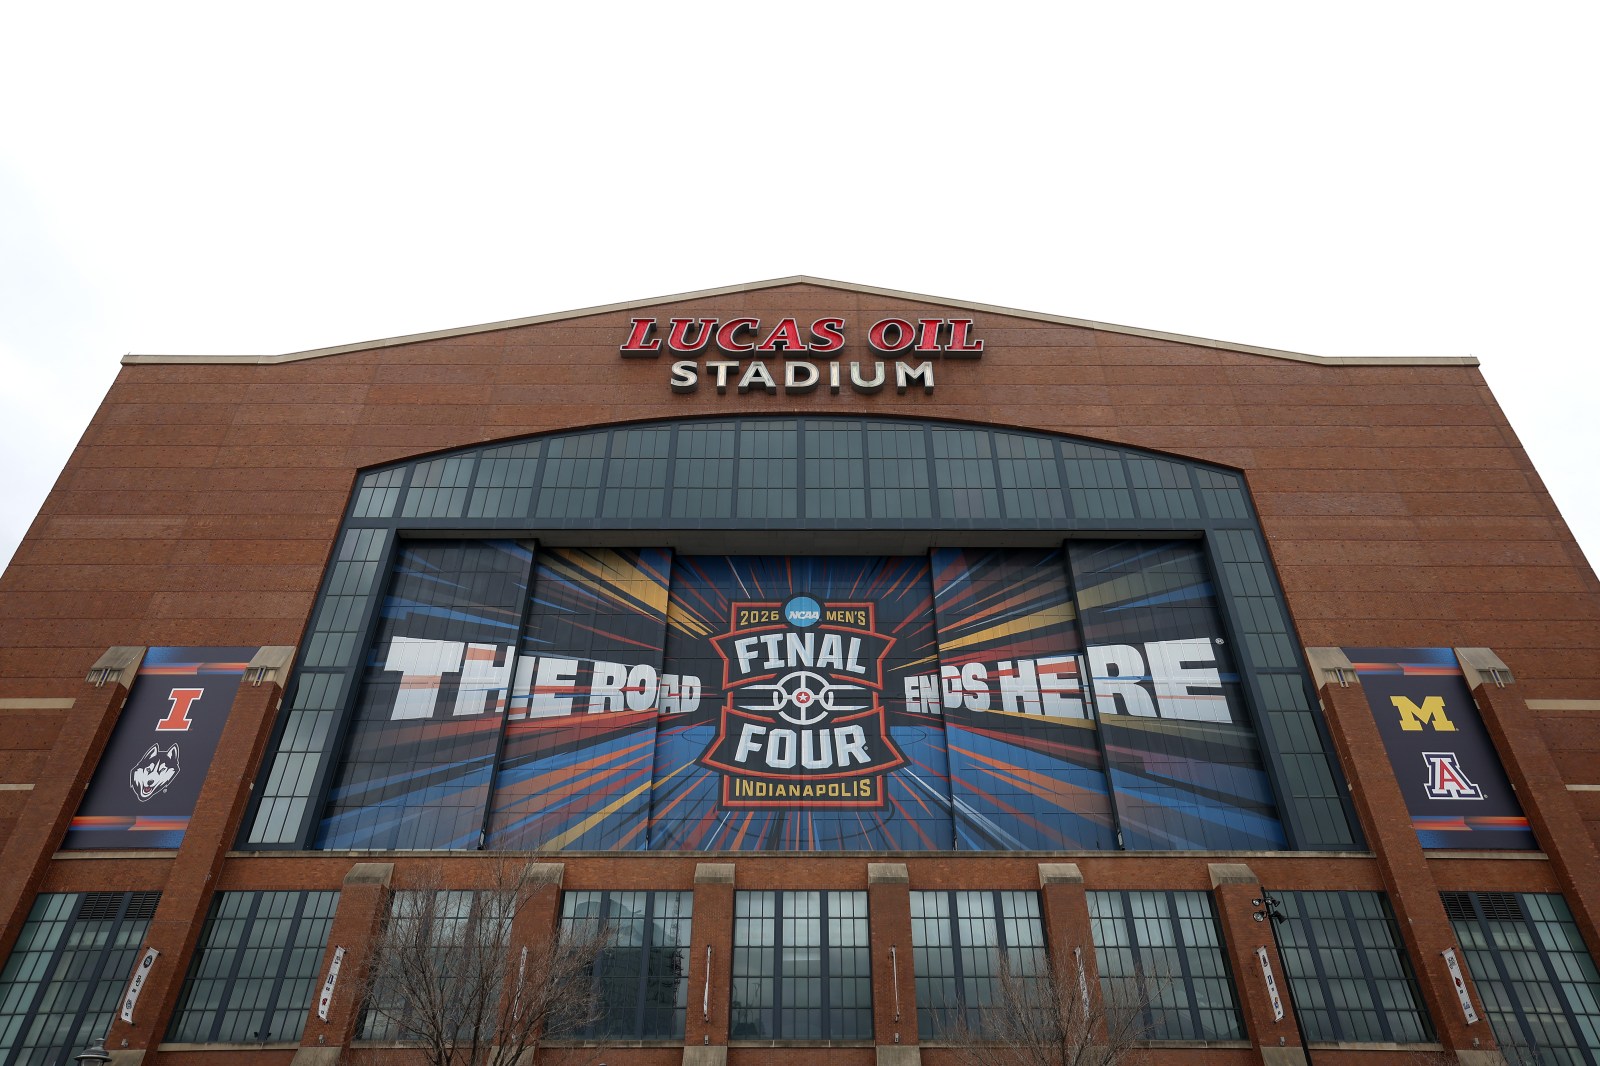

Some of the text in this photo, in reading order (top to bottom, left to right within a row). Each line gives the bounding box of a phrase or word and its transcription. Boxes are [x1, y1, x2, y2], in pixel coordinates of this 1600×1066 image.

[620, 317, 985, 358] LUCAS OIL
[670, 360, 936, 394] STADIUM
[740, 610, 866, 626] 2026 NCAA MEN'S
[734, 632, 867, 674] FINAL
[384, 636, 702, 720] THE ROAD
[903, 637, 1233, 724] ENDS HERE
[155, 687, 205, 731] I
[1389, 695, 1457, 731] M
[734, 723, 872, 769] FOUR
[735, 778, 872, 797] INDIANAPOLIS
[1421, 751, 1485, 800] A
